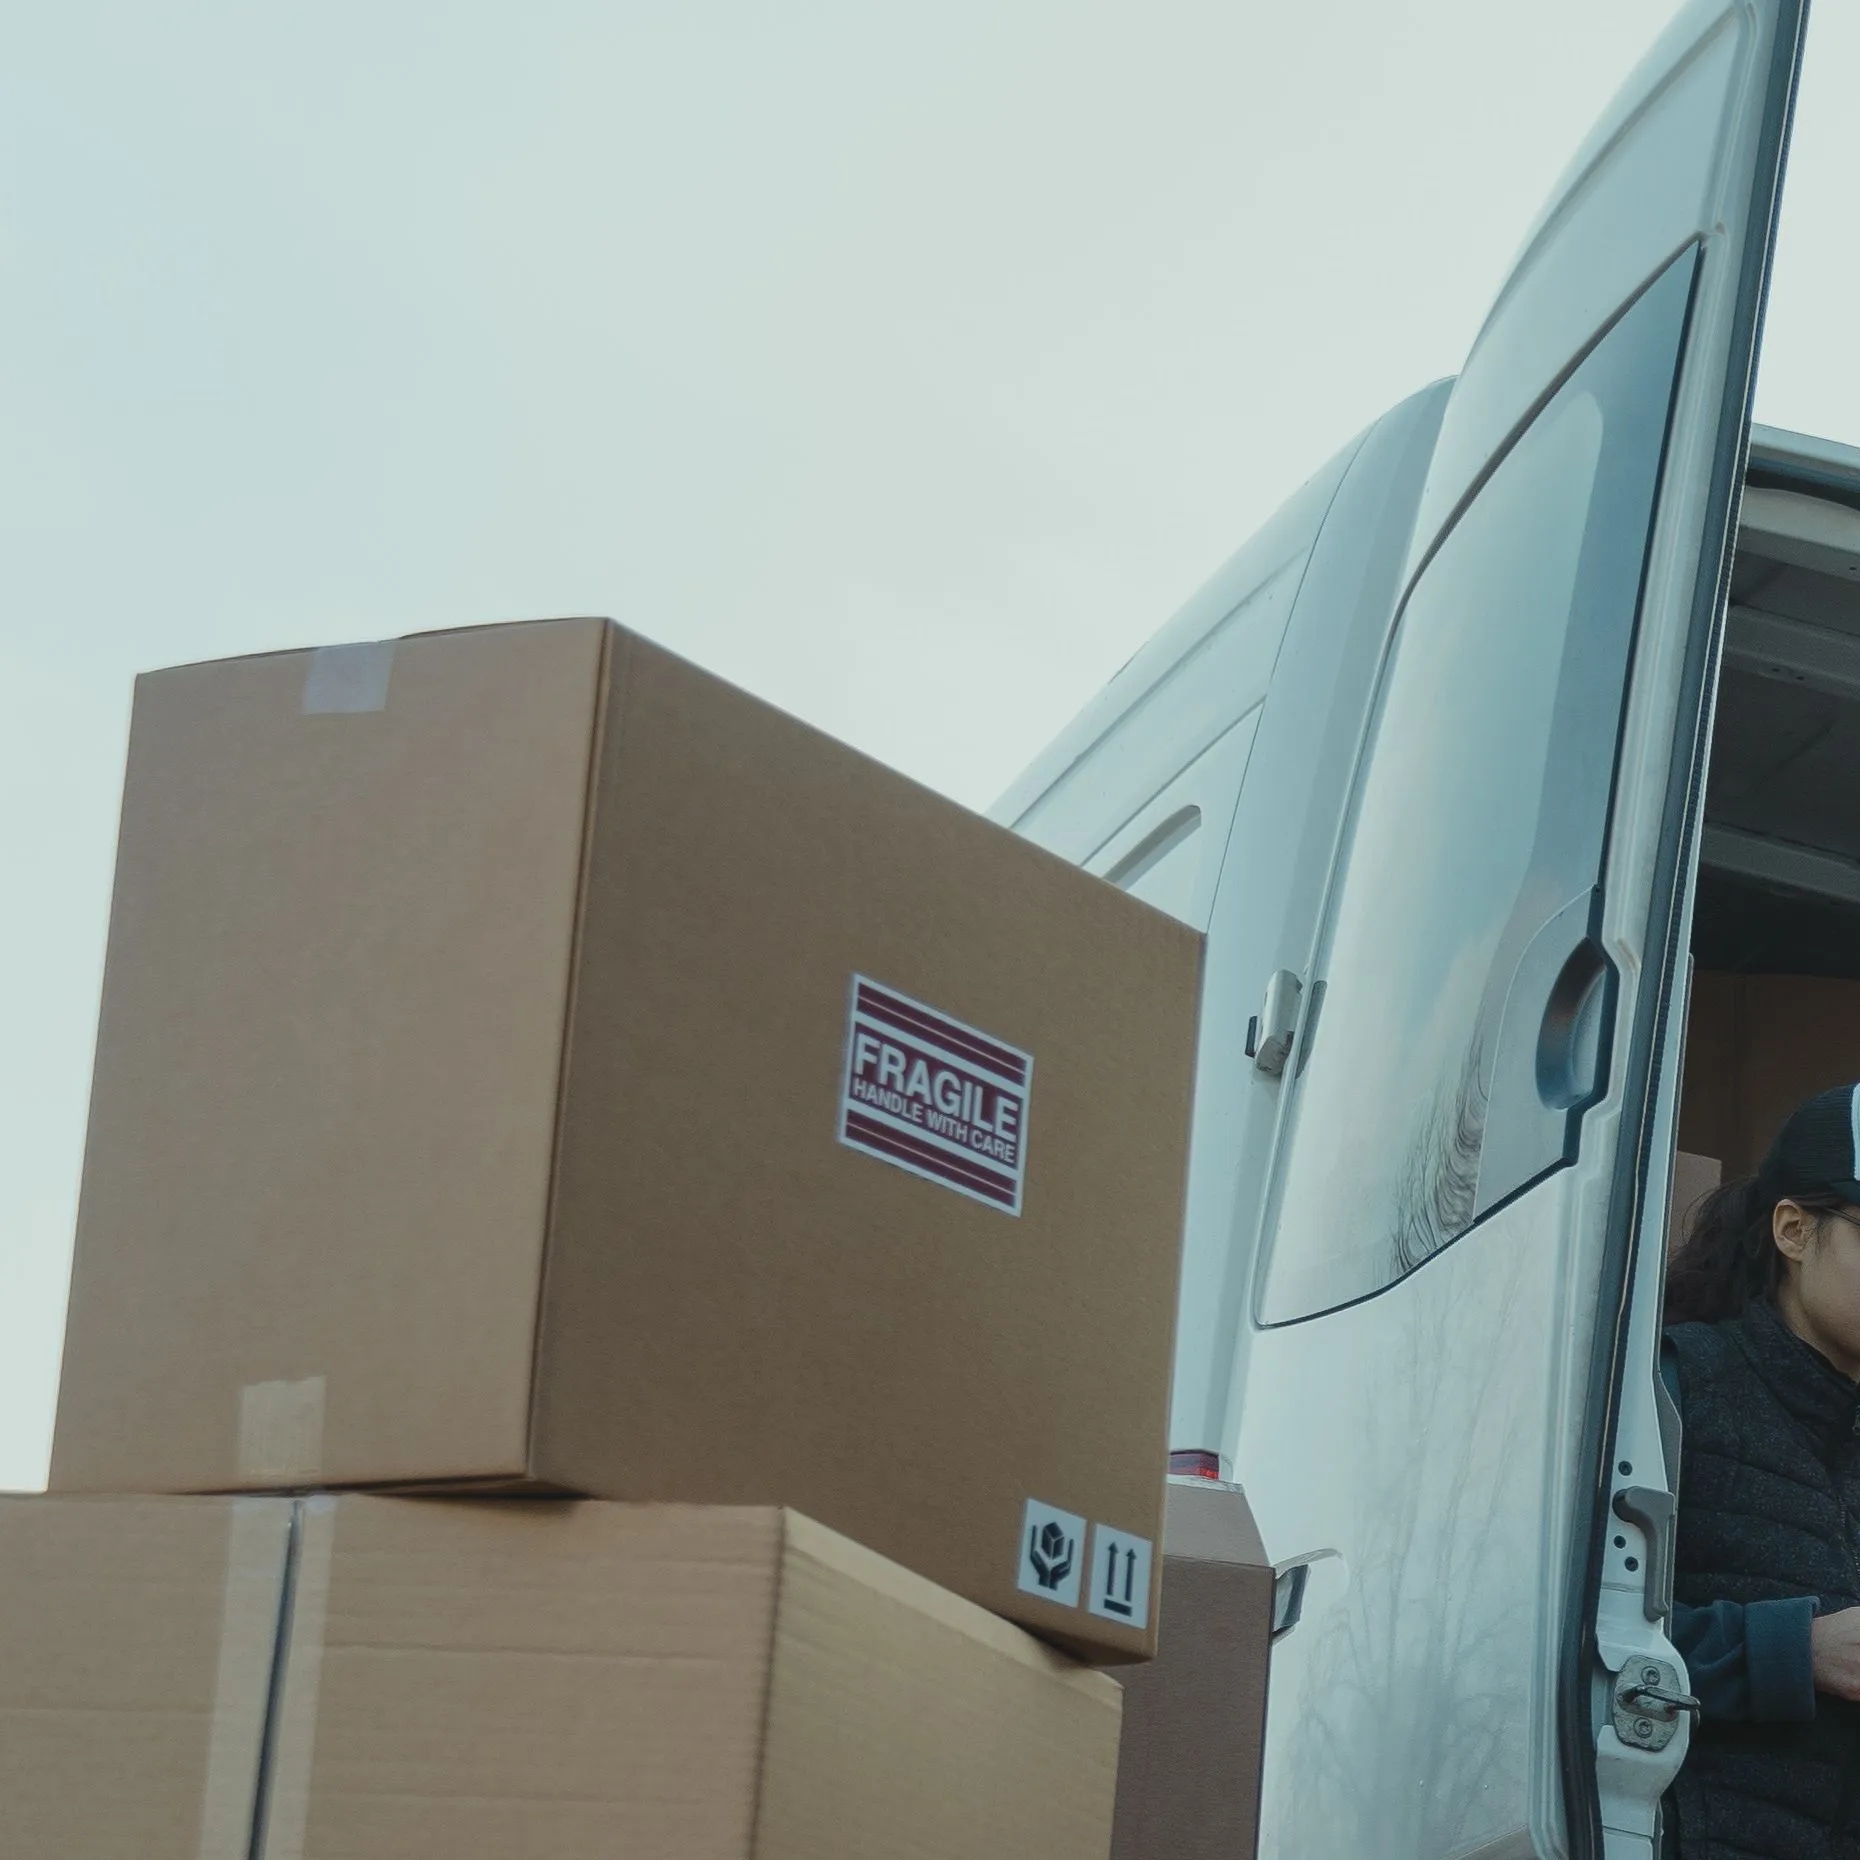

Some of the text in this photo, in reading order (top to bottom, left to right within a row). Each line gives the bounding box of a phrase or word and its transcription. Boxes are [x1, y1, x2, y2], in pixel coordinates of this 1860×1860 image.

[853, 1077, 1016, 1163] HANDLE WITH CARE
[855, 1033, 1019, 1142] FRAGILE
